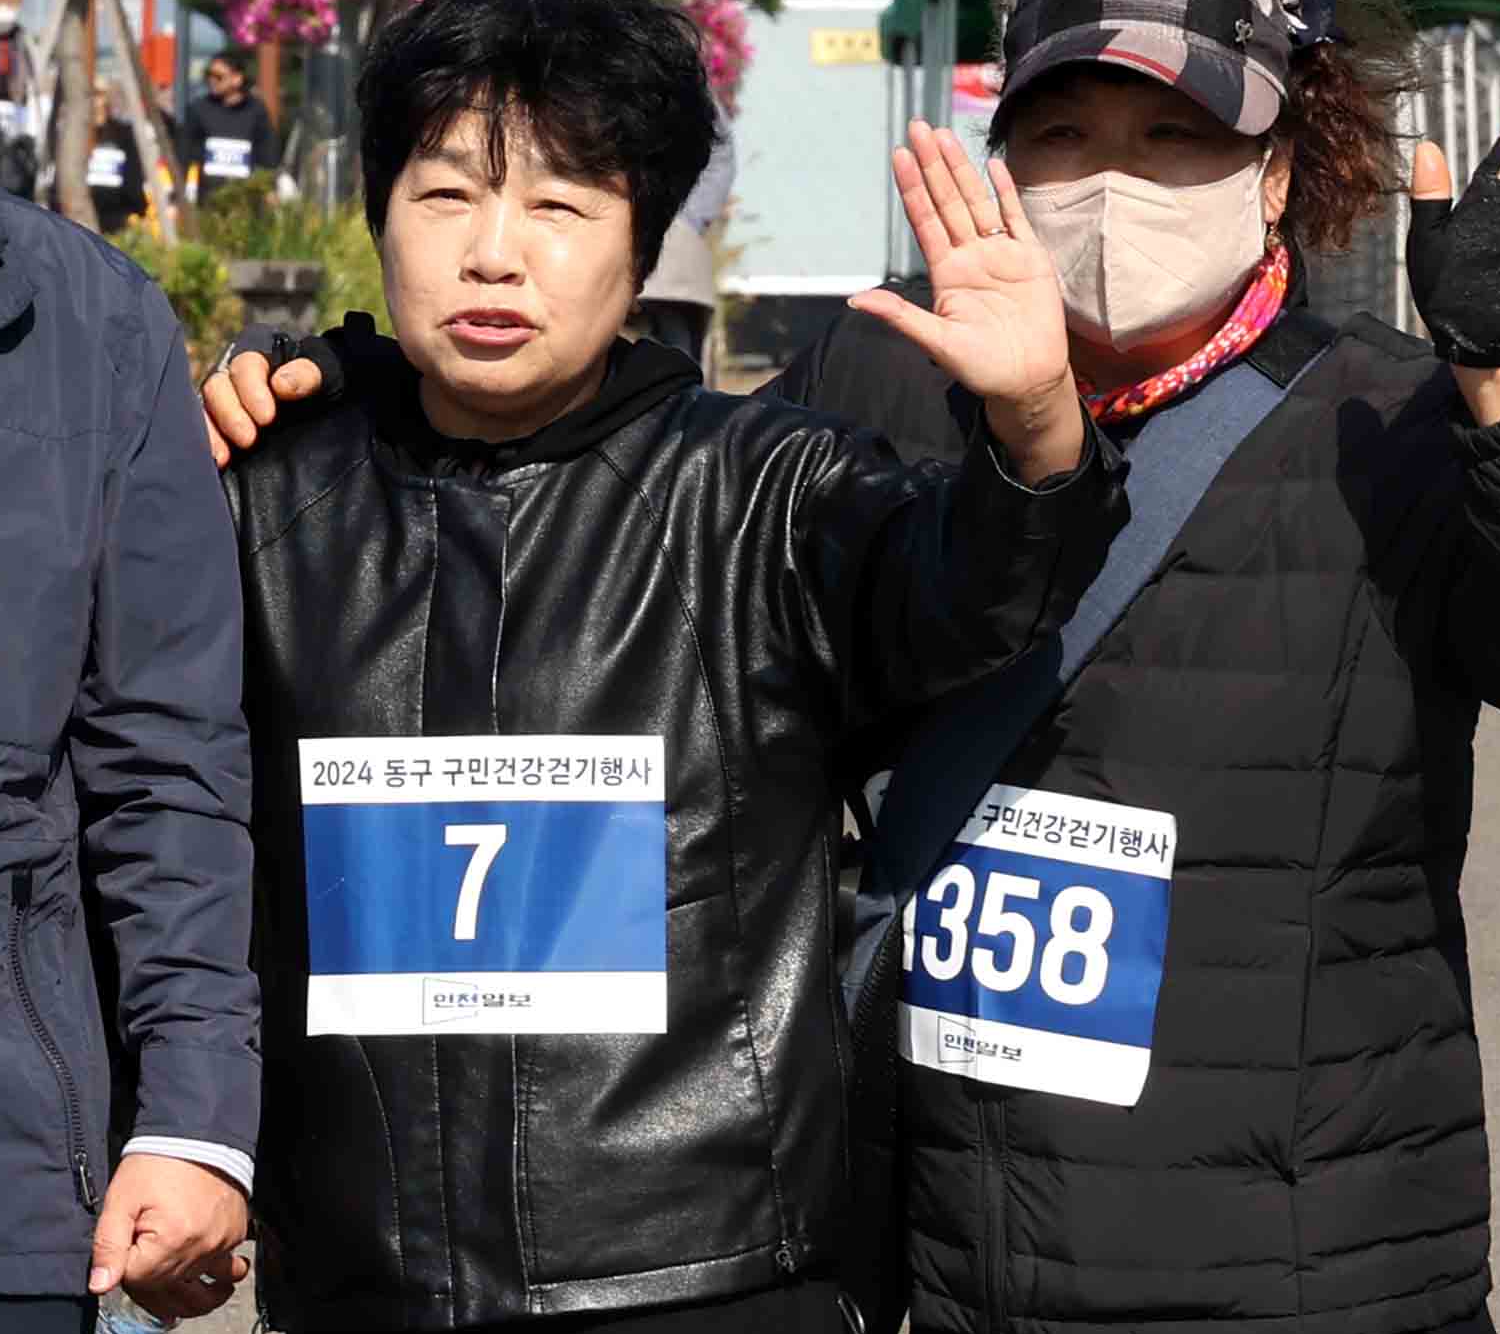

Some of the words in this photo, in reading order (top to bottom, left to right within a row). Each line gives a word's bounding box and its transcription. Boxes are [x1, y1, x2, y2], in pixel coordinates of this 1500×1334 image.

[312, 761, 373, 787] 2024
[383, 759, 433, 787] 동구
[442, 756, 652, 786] 구민건강걷기행사
[982, 803, 1169, 863] 구민건강걷기행사
[444, 824, 508, 940] 7
[433, 993, 532, 1008] 인천일보
[944, 1034, 1022, 1061] 인천일보
